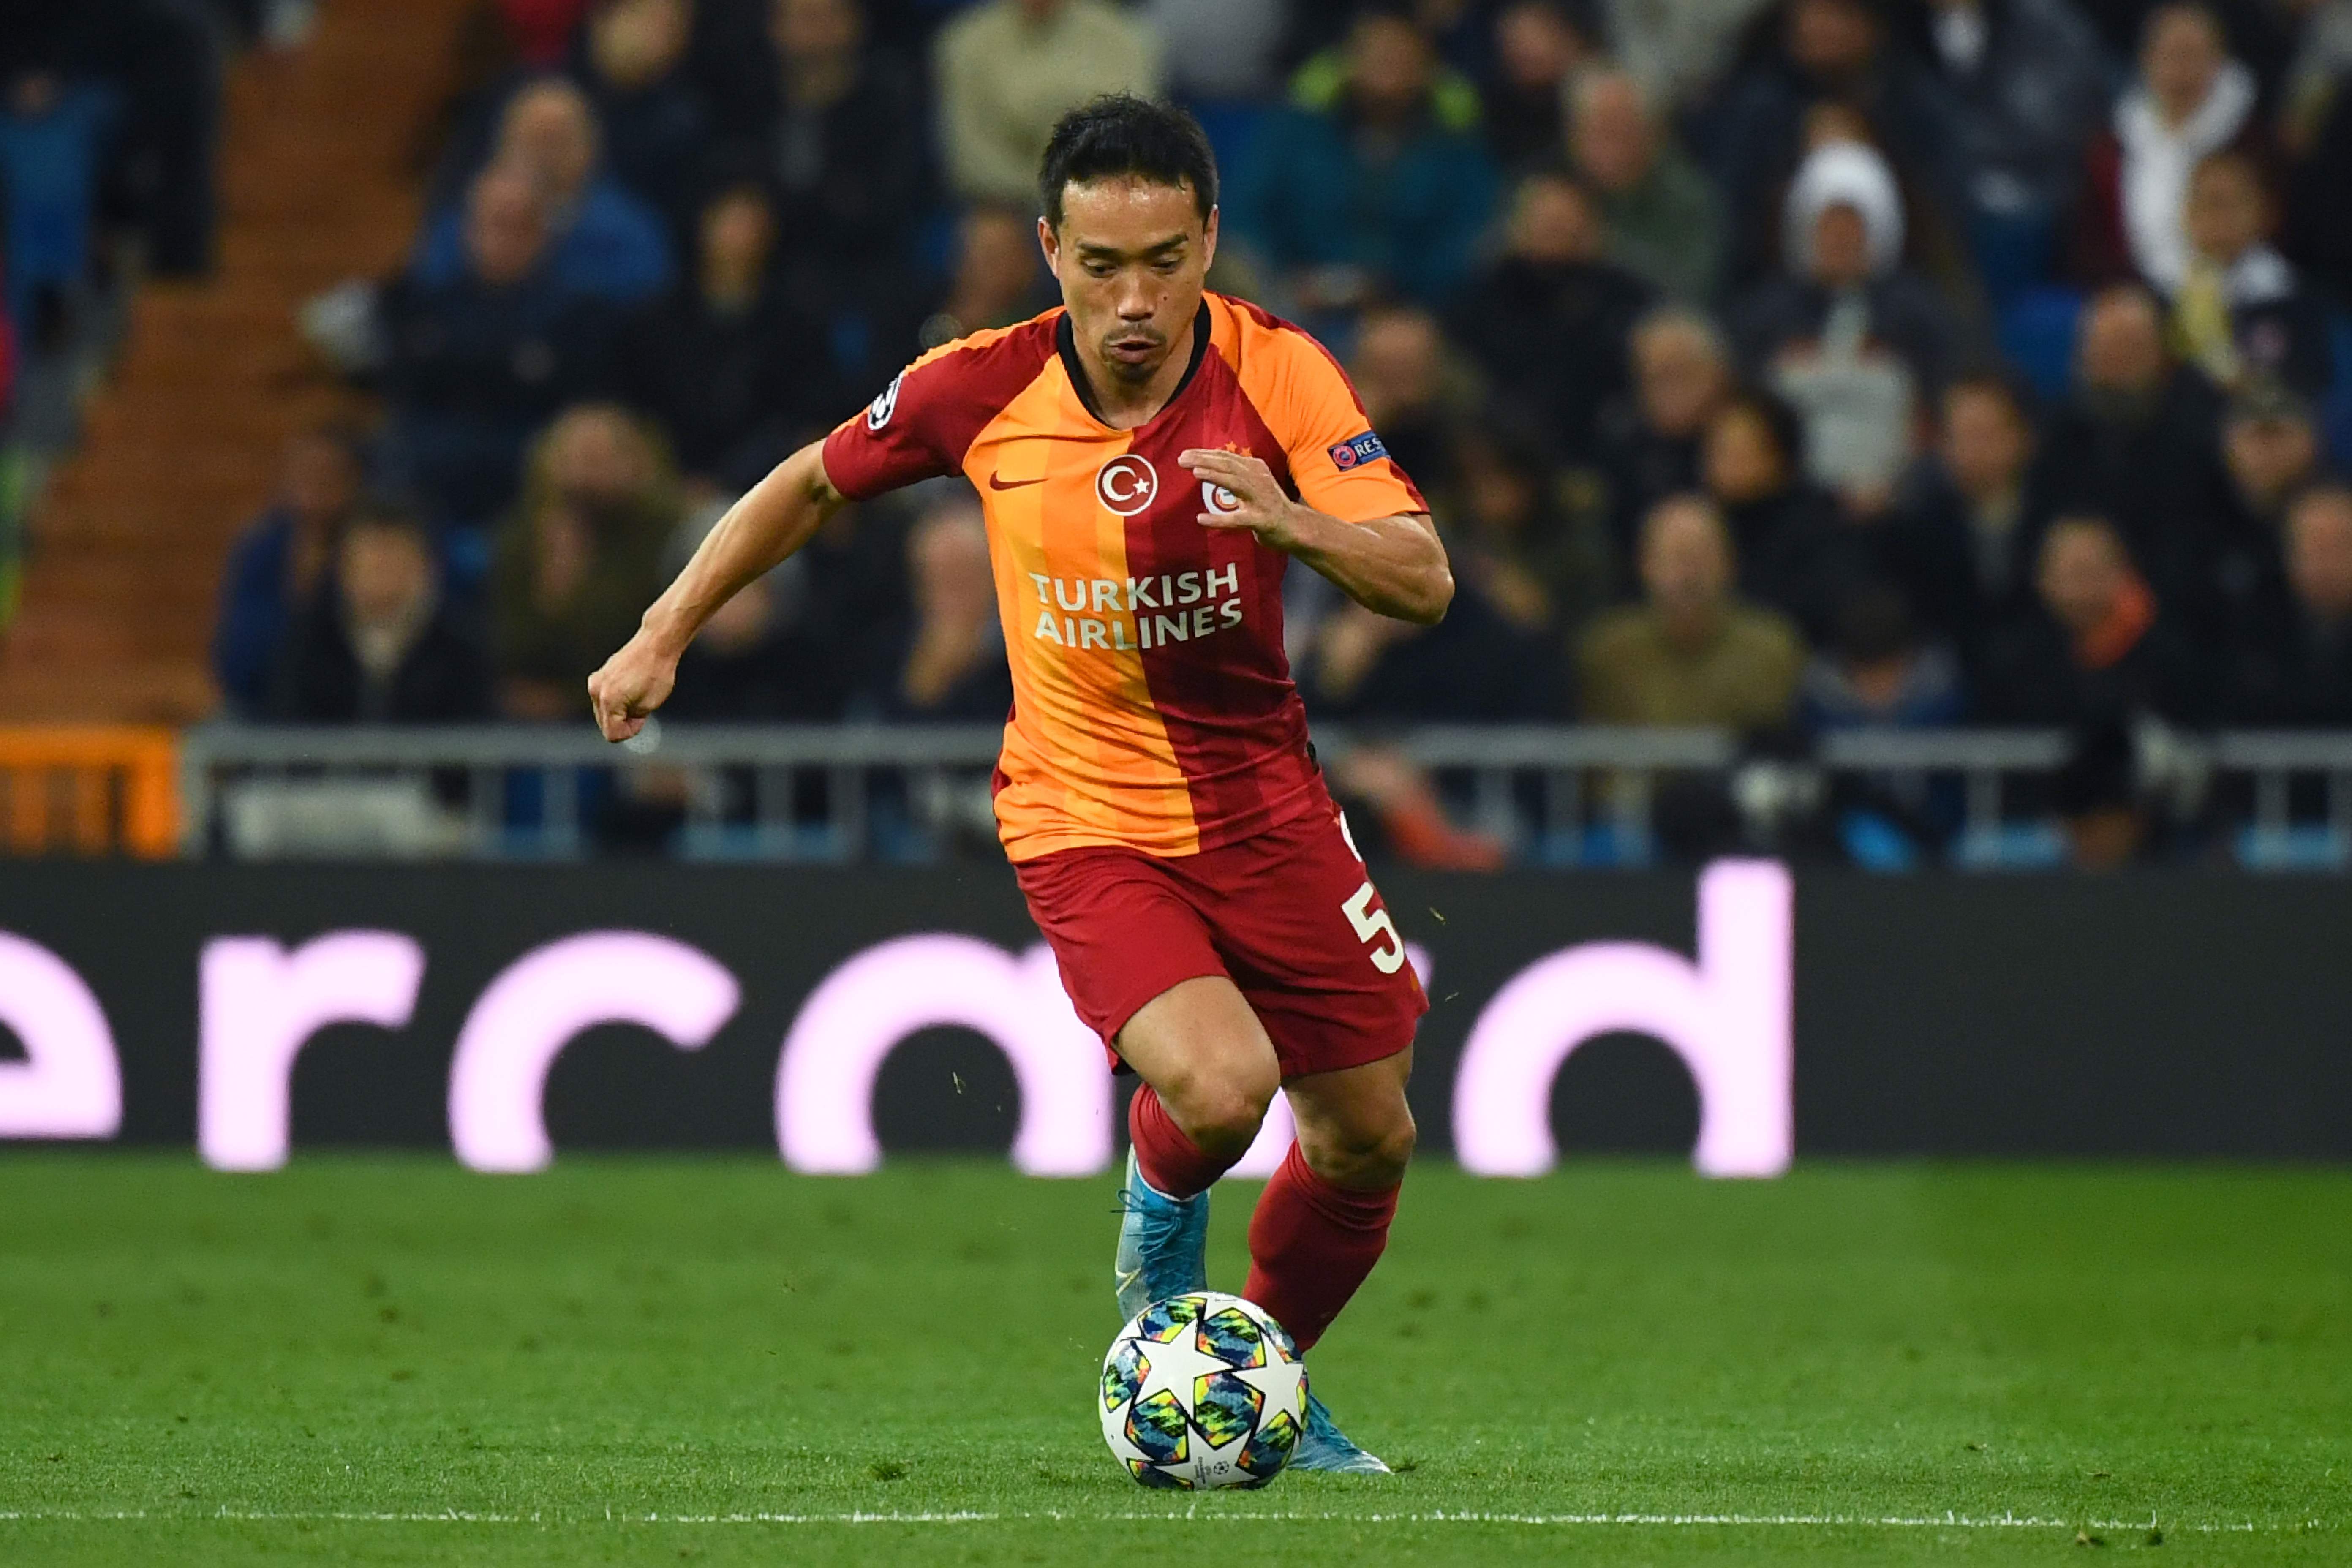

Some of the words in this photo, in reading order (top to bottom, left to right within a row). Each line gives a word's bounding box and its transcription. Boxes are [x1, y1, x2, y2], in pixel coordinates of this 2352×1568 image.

[1354, 436, 1387, 457] RES
[1028, 562, 1239, 612] TURKISH
[1034, 598, 1243, 650] AIRLINES
[1341, 882, 1405, 974] 5
[0, 860, 1794, 1179] rcad
